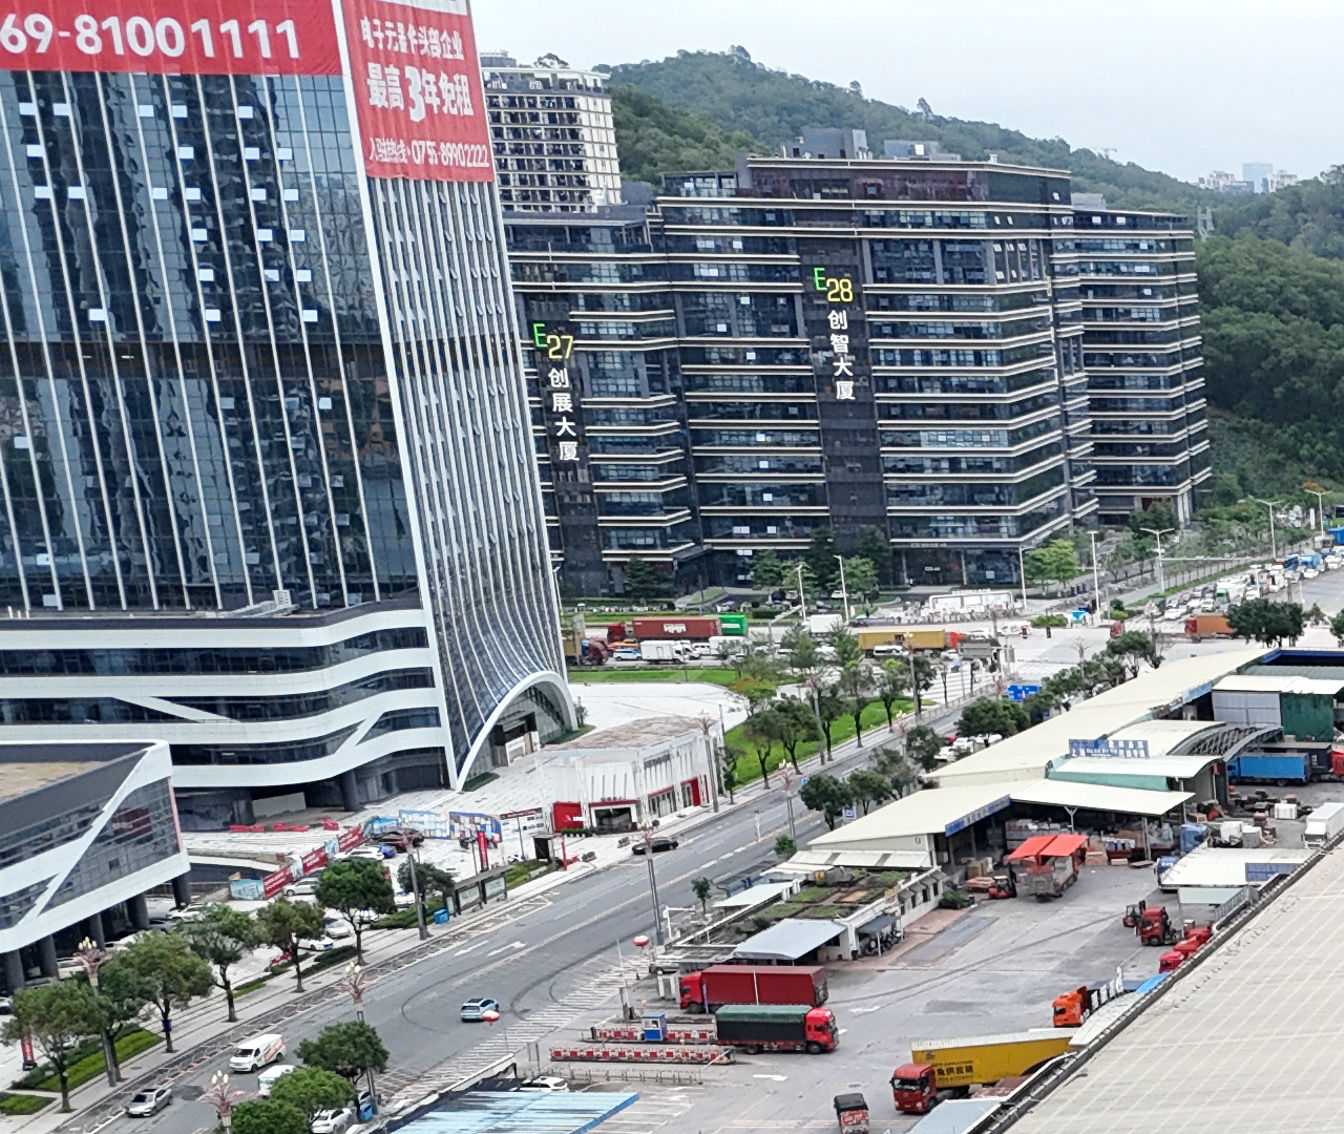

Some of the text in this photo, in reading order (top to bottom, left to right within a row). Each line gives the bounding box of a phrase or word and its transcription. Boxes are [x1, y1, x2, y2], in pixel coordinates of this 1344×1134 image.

[360, 16, 465, 60] 电子元器件头部企业
[366, 62, 474, 123] 最高3年免租
[813, 267, 854, 302] E28
[532, 323, 574, 359] E27
[827, 309, 856, 400] 创智大厦
[547, 367, 580, 461] 创展大厦
